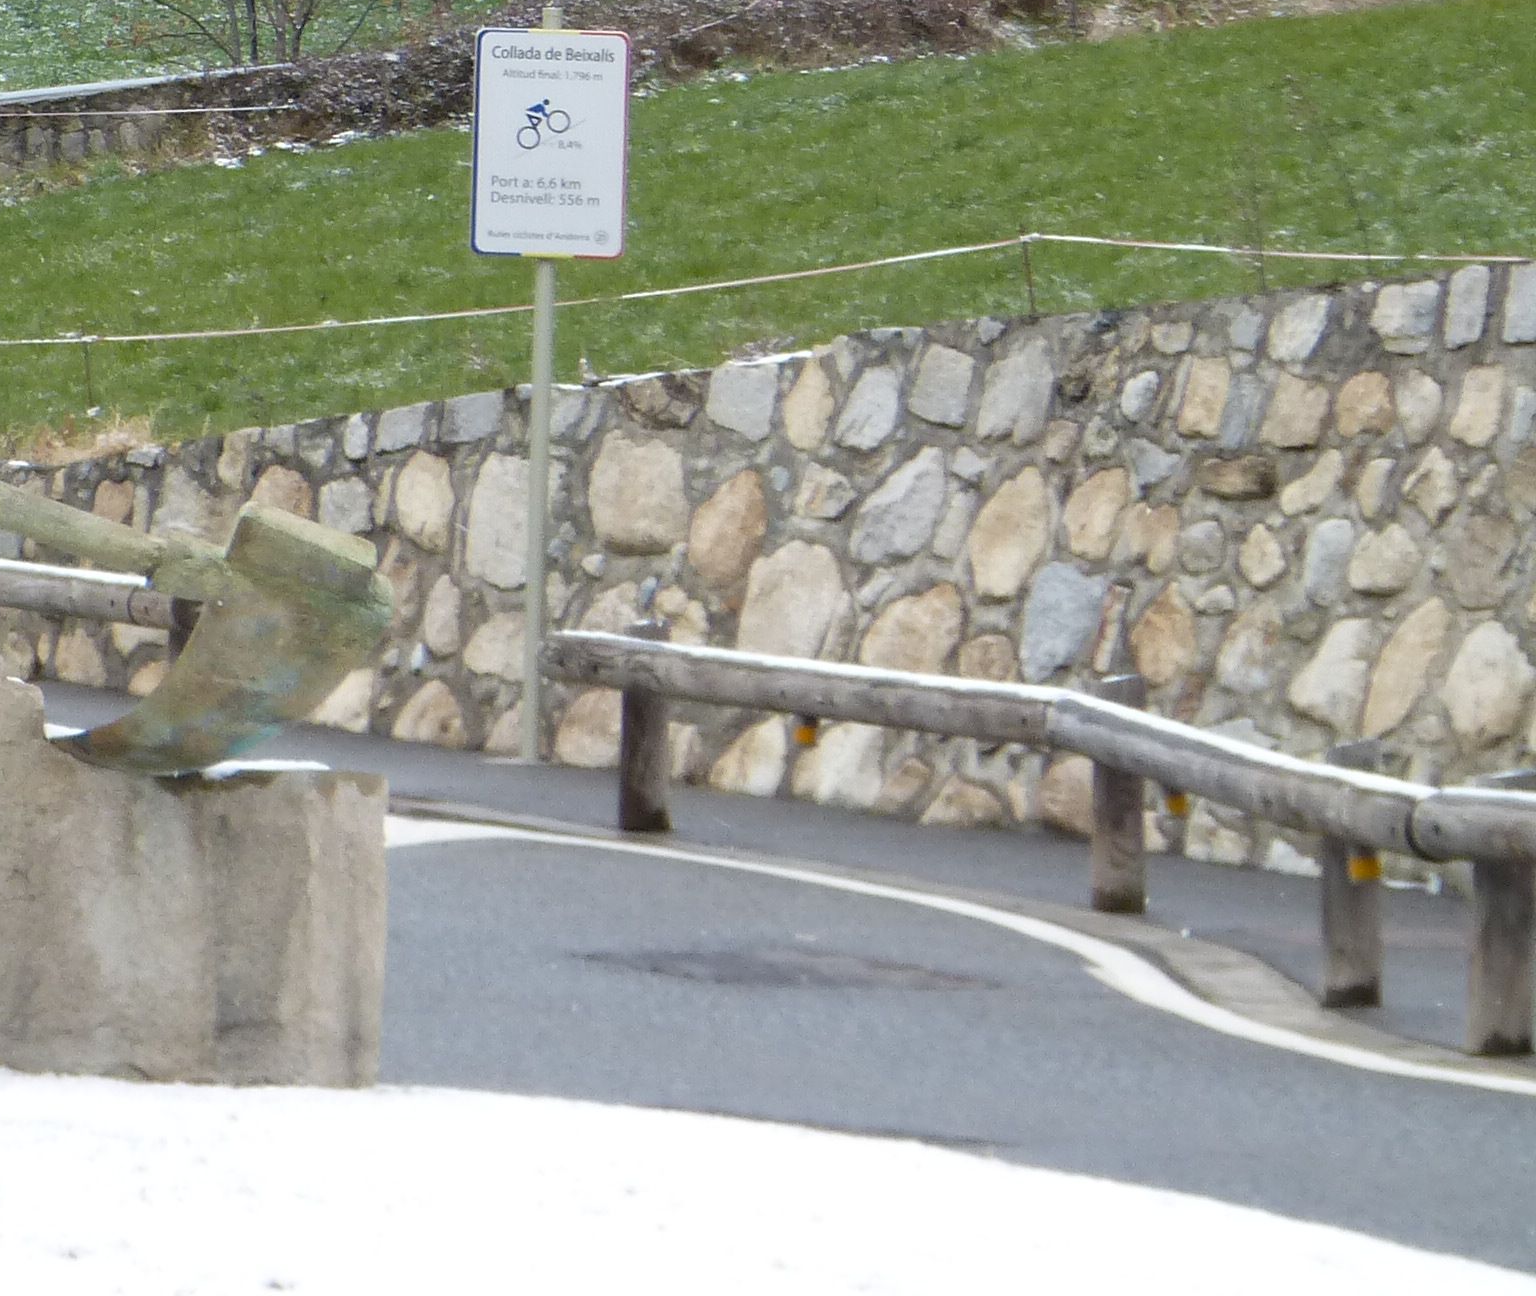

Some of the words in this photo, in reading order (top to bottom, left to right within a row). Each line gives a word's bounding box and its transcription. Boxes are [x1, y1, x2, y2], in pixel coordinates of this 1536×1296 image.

[491, 45, 542, 60] Collada
[545, 47, 562, 61] de
[565, 47, 615, 63] Beixalís
[502, 69, 536, 79] Altitud
[593, 73, 603, 81] m
[491, 175, 518, 188] Port
[522, 178, 533, 188] a:
[536, 177, 557, 190] 6,6
[560, 179, 581, 190] km
[559, 194, 583, 206] 556
[587, 196, 600, 206] m
